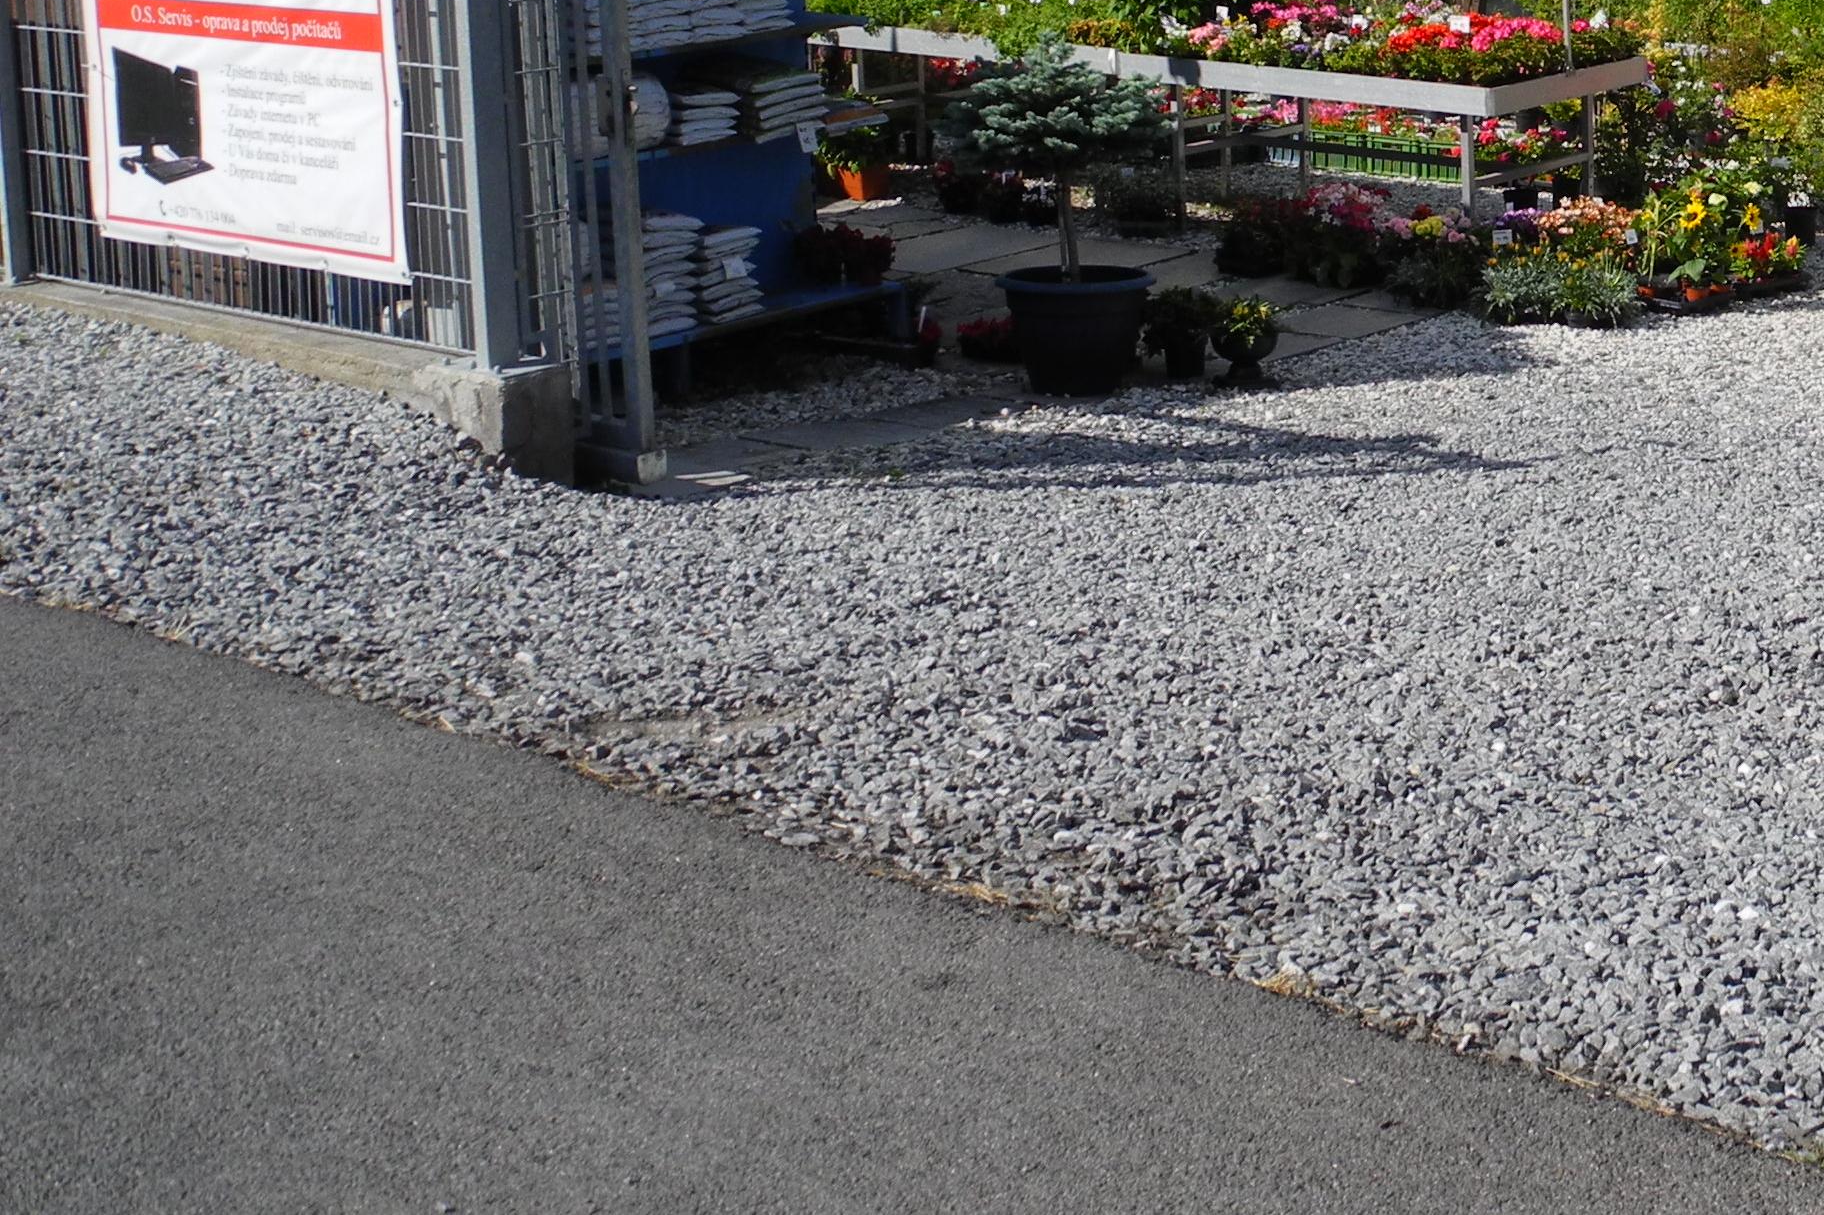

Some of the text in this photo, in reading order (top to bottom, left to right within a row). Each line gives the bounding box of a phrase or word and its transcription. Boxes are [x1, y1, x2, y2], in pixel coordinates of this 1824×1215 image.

[130, 3, 156, 24] O.S.
[157, 6, 193, 27] Servis
[202, 14, 241, 34] oprava
[242, 18, 250, 33] a
[251, 15, 290, 40] prodej
[292, 18, 343, 41] počítačů
